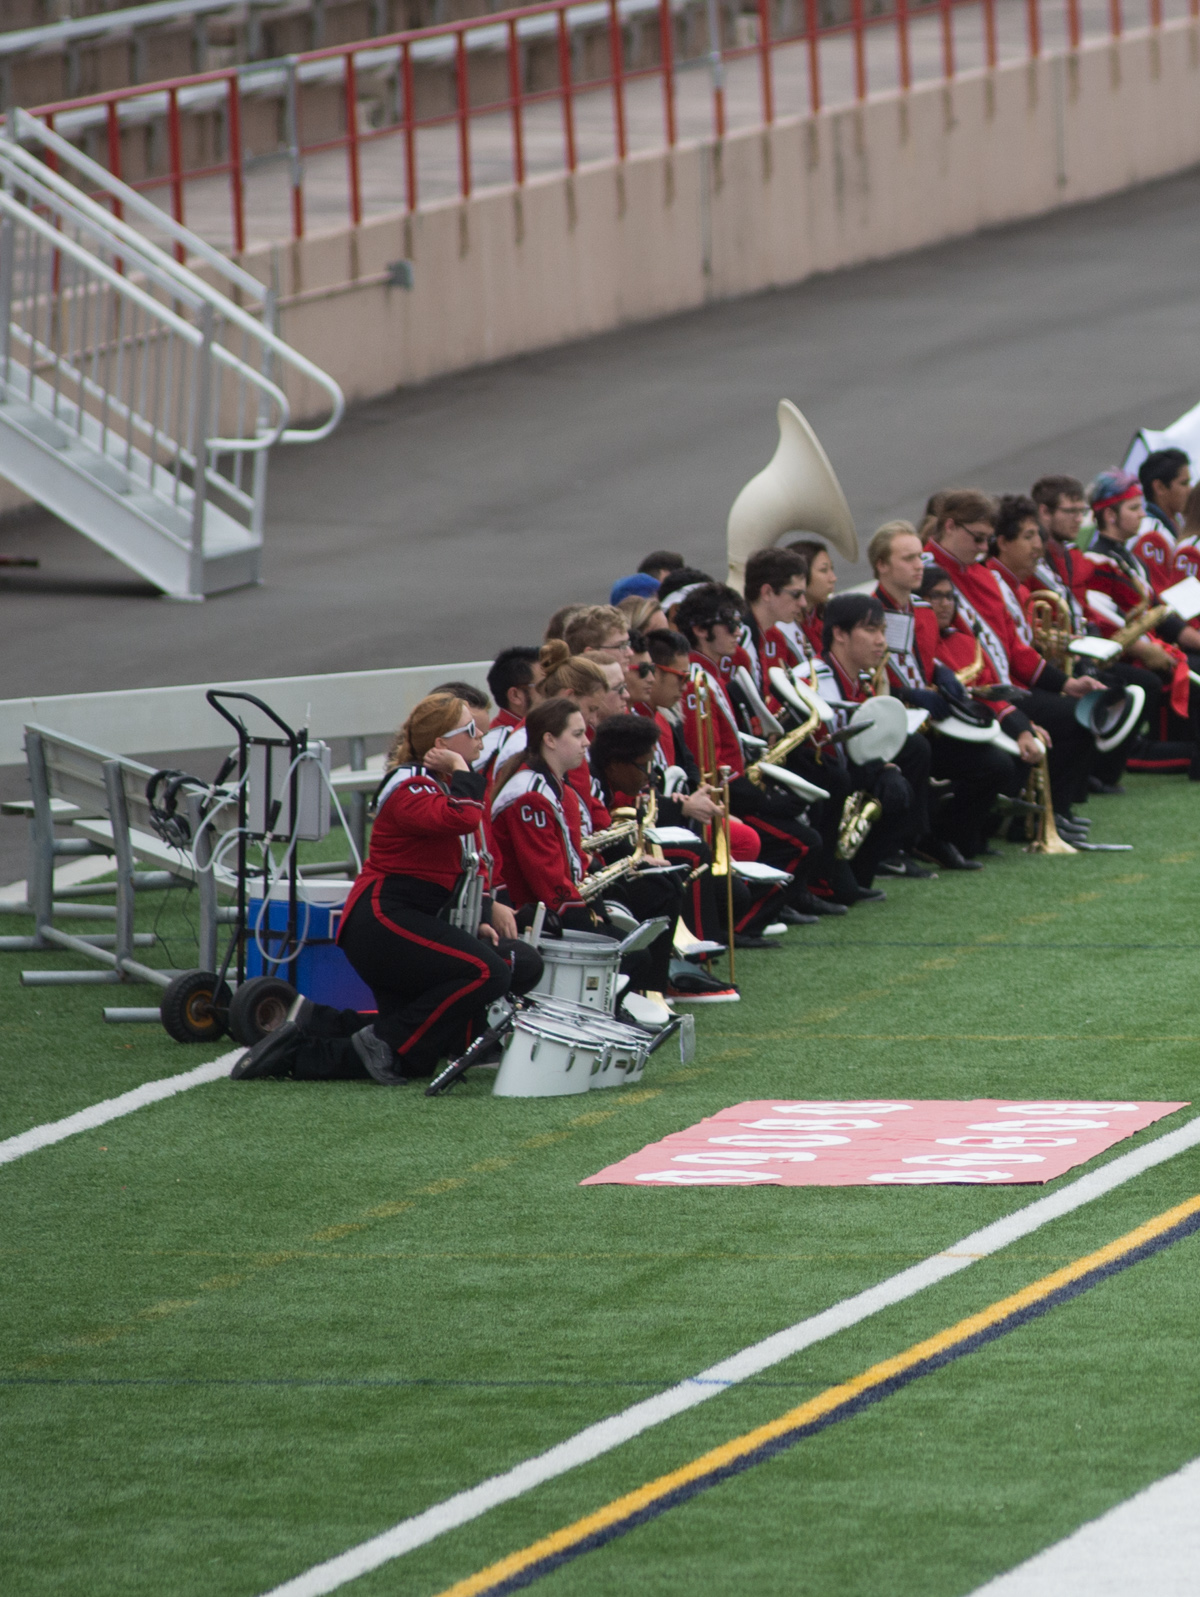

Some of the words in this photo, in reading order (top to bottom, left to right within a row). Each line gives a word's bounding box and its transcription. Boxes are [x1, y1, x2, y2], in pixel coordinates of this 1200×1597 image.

[1142, 541, 1165, 564] CU
[1176, 554, 1199, 577] CU
[520, 804, 547, 828] CU
